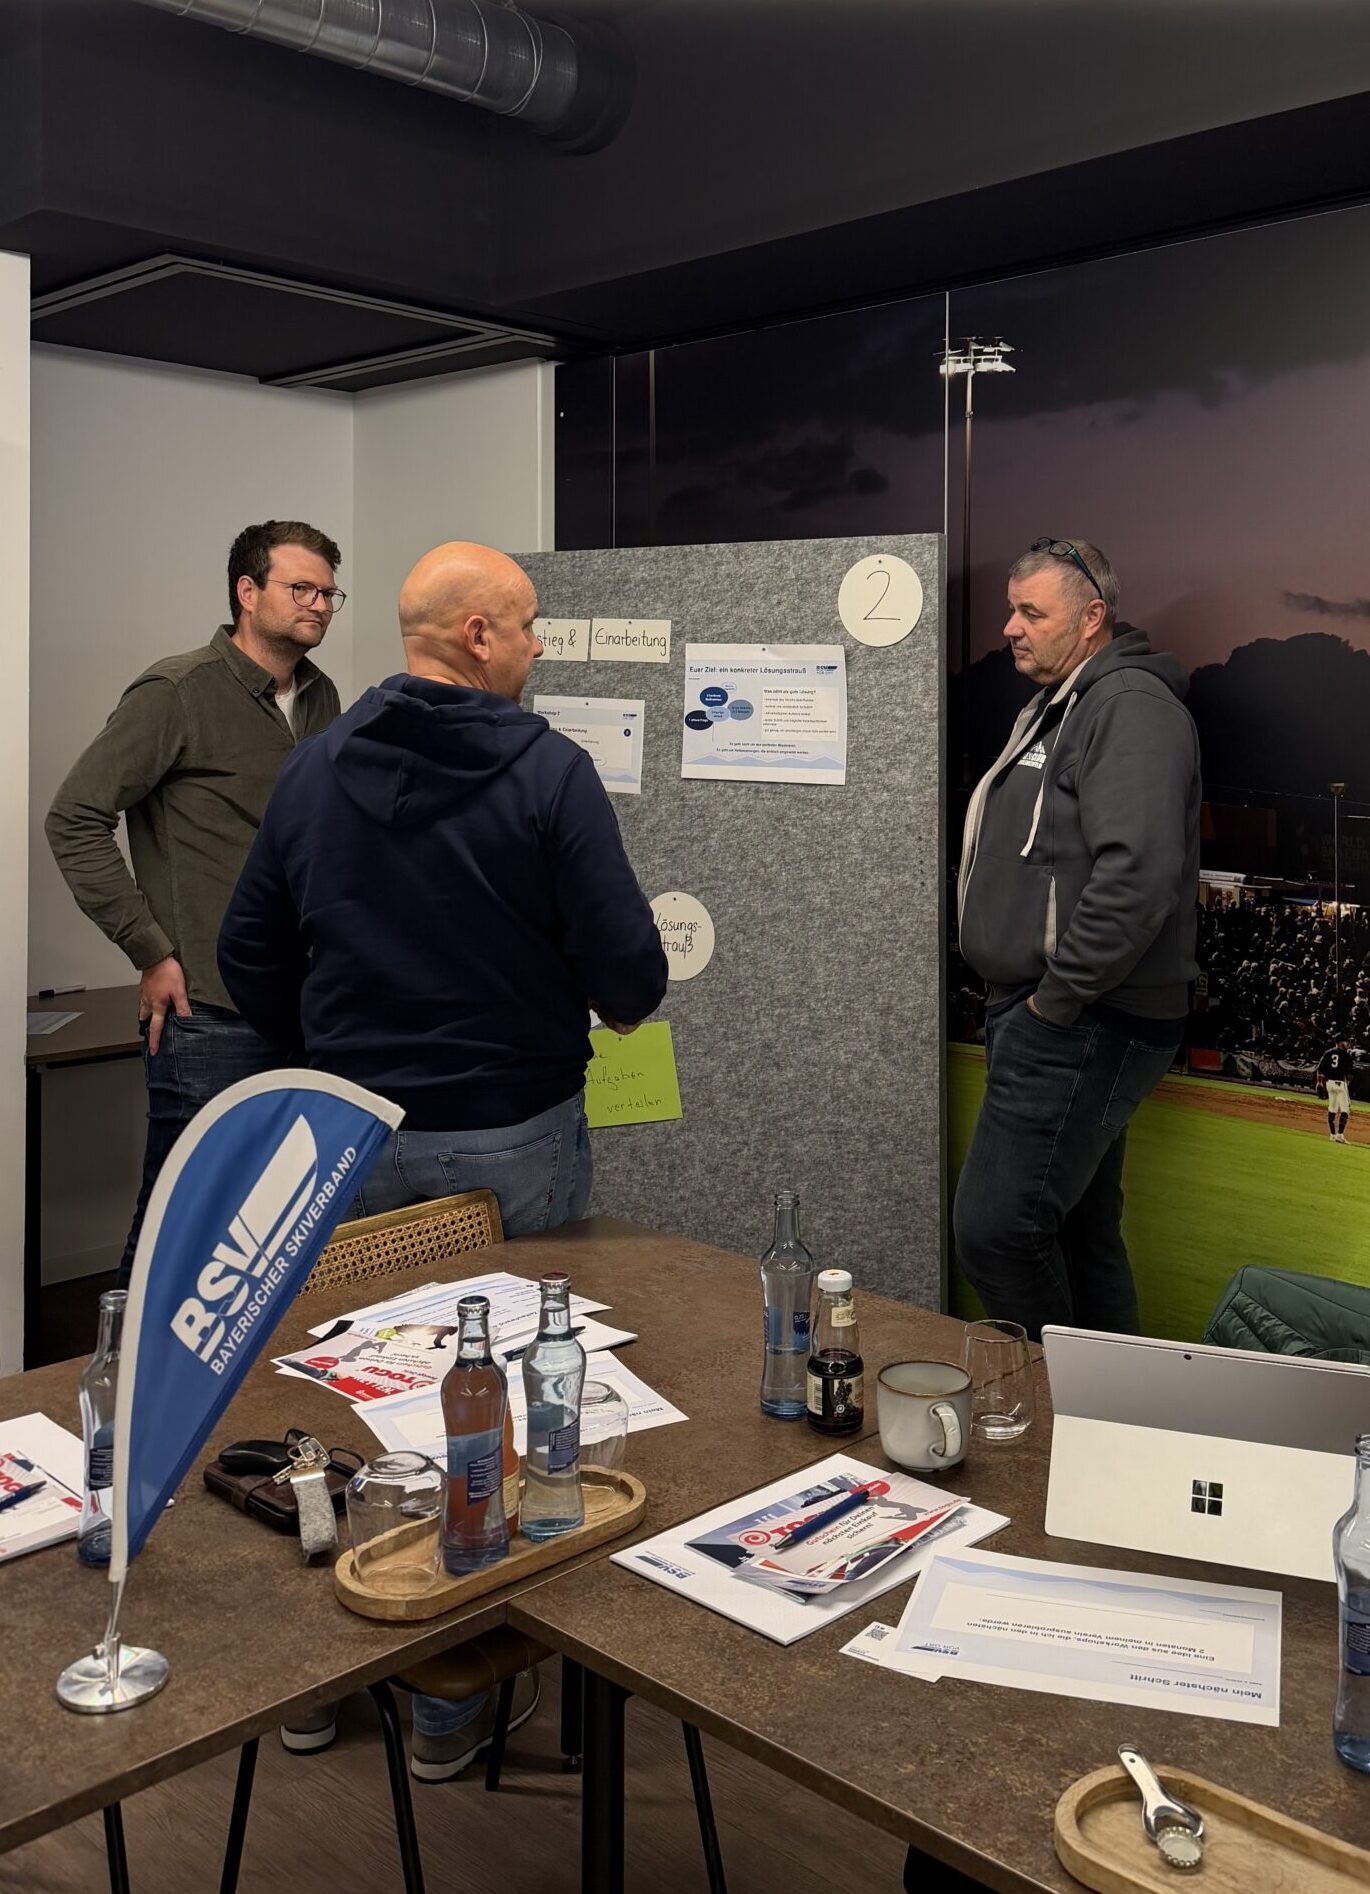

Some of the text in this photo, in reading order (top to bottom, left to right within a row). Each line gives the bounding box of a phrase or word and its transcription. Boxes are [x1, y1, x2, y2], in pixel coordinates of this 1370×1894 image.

[863, 570, 901, 621] 2
[568, 628, 577, 648] &
[595, 628, 667, 656] Einarbeitung
[760, 667, 806, 676] Lösungsstrauß
[1330, 1054, 1340, 1068] 3
[586, 1066, 645, 1091] Aufgaben
[606, 1095, 663, 1114] verteilen
[209, 1146, 357, 1376] BAYERISCHER SKIVERBAND
[360, 1366, 417, 1384] TOGU
[806, 1506, 876, 1546] Gutschein für Deinen
[822, 1511, 880, 1546] nächsten Einkauf
[966, 1622, 1008, 1632] nächsten
[1011, 1622, 1072, 1634] ausprobieren
[1073, 1636, 1128, 1648] Workshops,
[1074, 1631, 1103, 1640] Verein
[1106, 1636, 1142, 1644] meinem
[1156, 1642, 1196, 1653] Monaten
[1171, 1650, 1192, 1658] Idee
[1194, 1654, 1215, 1662] Eine
[1130, 1674, 1171, 1686] Schritt
[1174, 1679, 1228, 1694] nächster
[1232, 1688, 1262, 1699] Mein
